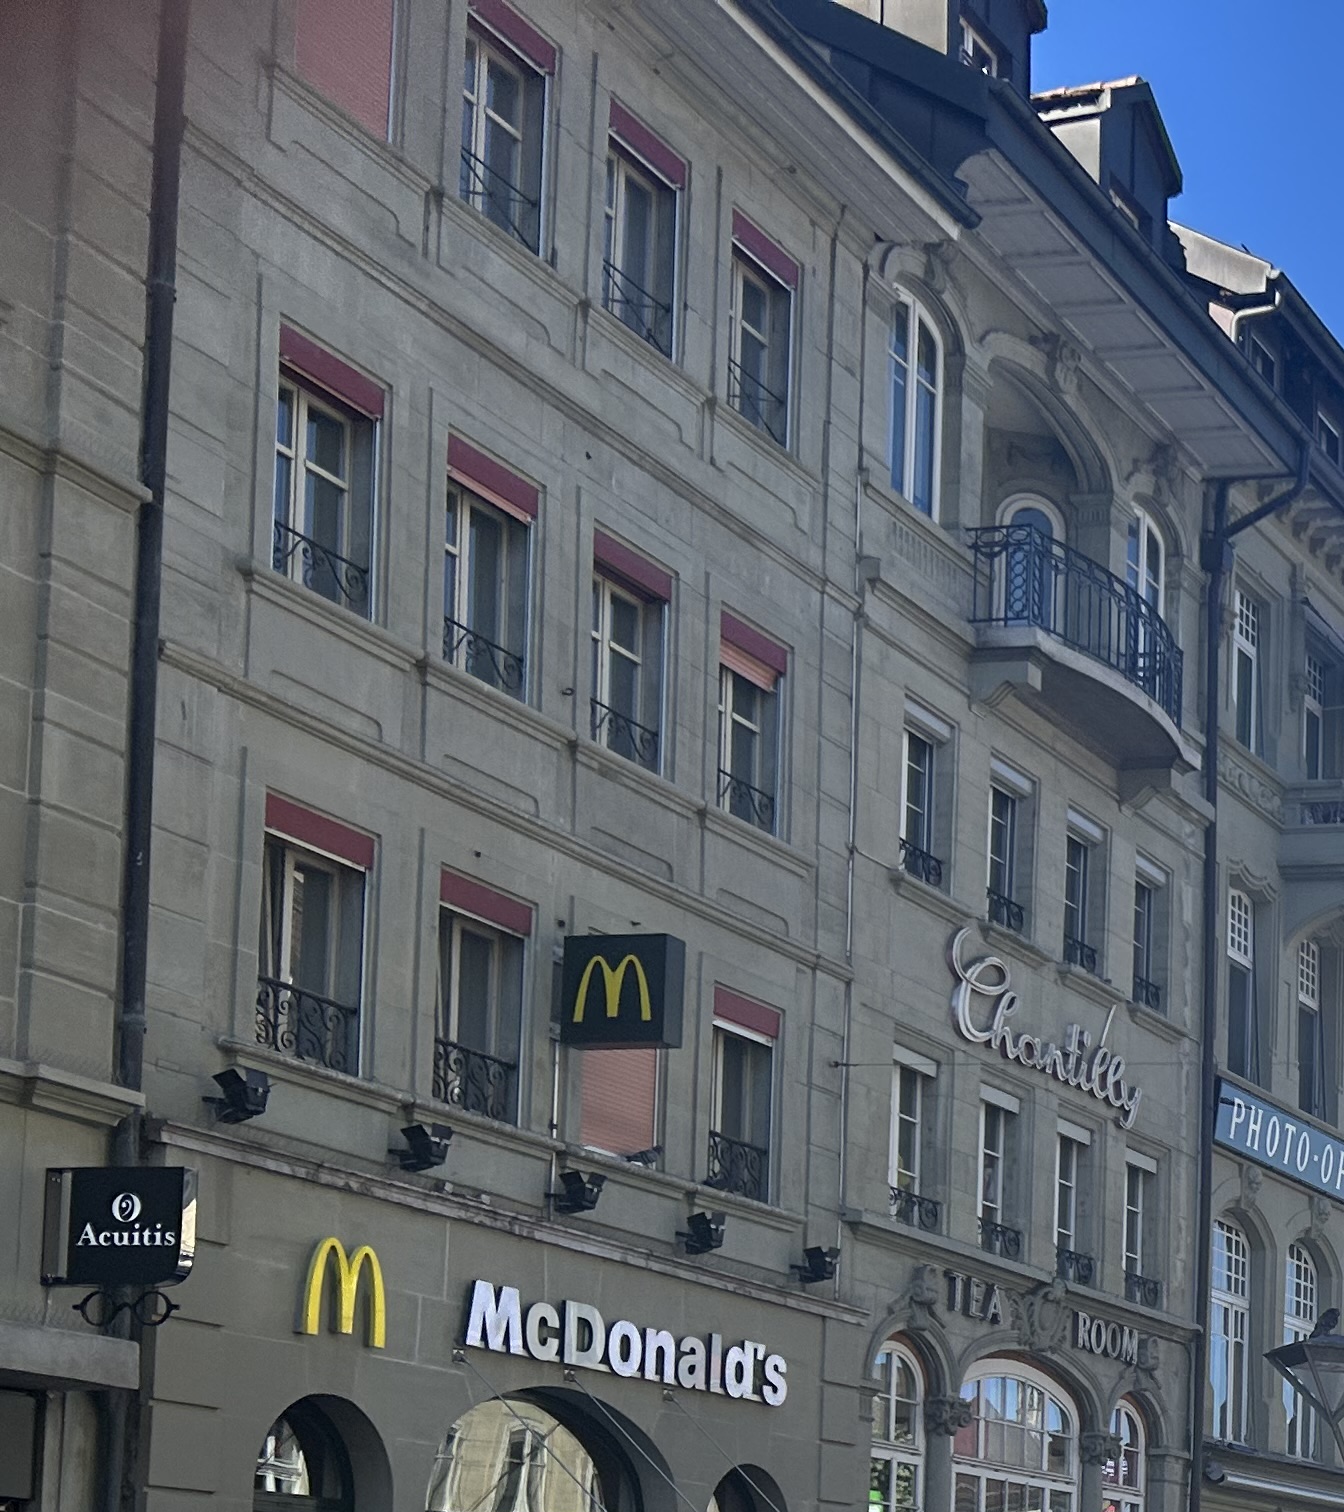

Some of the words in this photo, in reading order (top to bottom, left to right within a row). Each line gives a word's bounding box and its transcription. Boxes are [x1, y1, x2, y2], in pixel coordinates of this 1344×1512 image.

[952, 926, 1142, 1129] Chantilly
[76, 1221, 176, 1249] Acuitis
[465, 1279, 788, 1407] McDonald's
[949, 1271, 1002, 1325] TEA
[1076, 1311, 1139, 1366] ROOM
